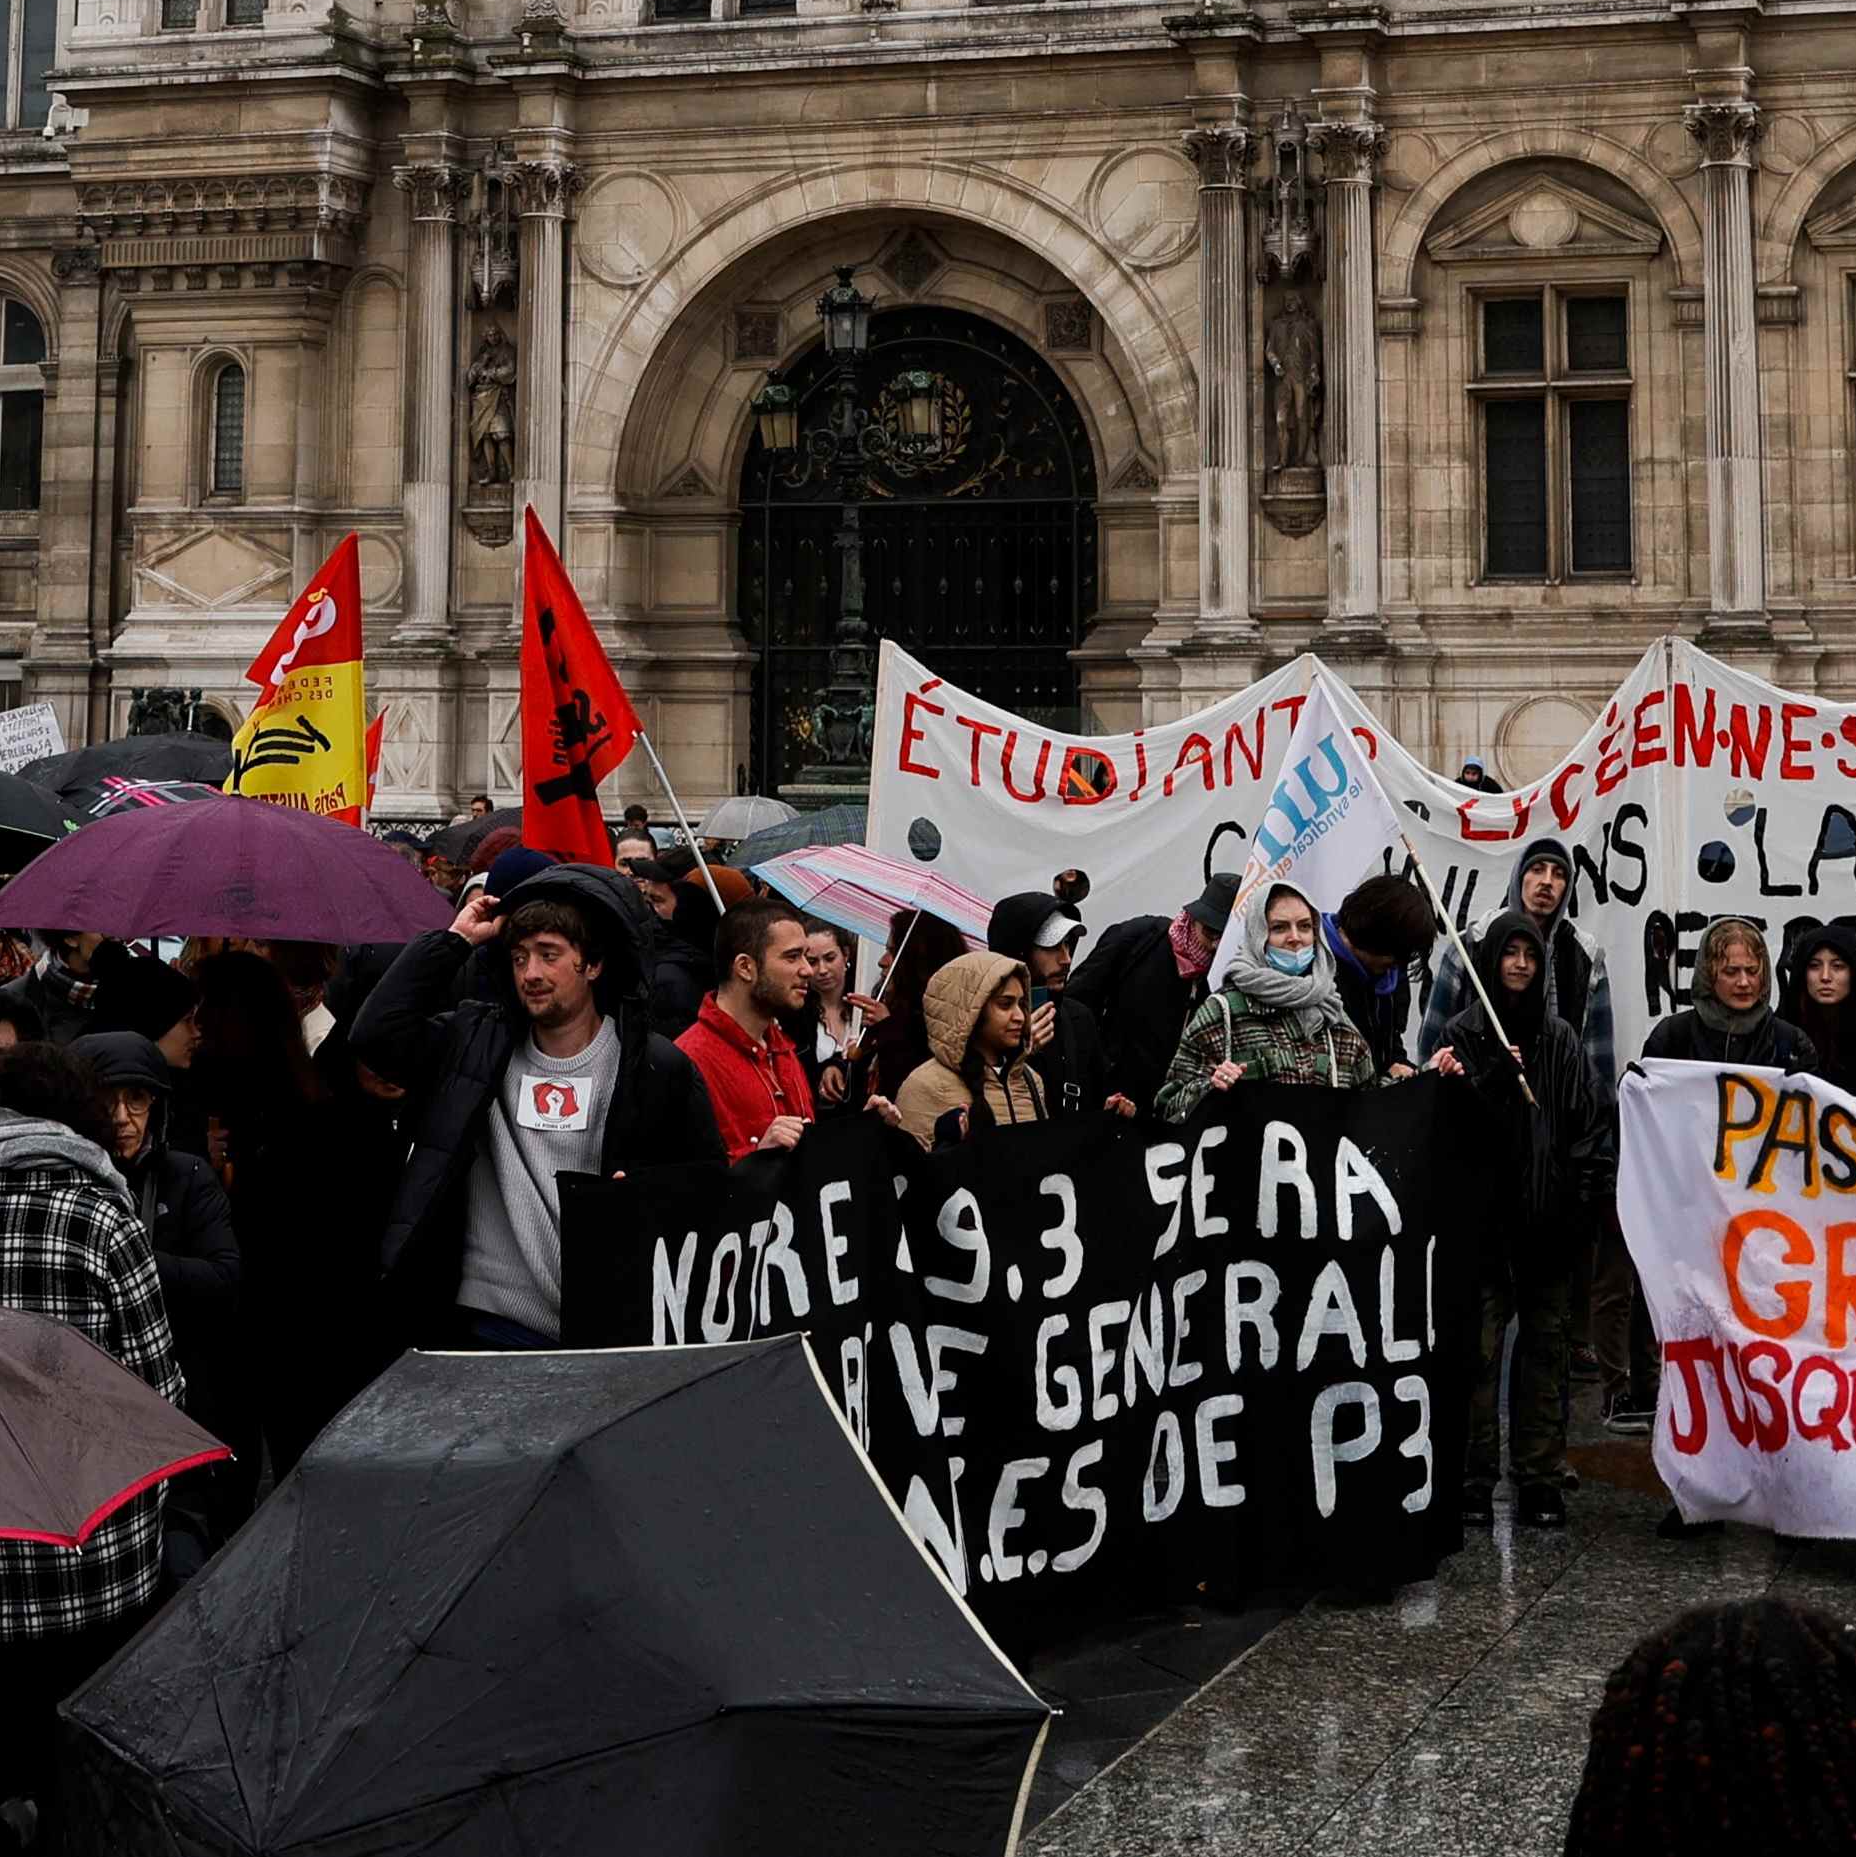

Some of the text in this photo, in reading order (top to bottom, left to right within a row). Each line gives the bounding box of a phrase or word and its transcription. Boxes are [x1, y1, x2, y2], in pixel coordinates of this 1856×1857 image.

[651, 1178, 861, 1348] NOTRE
[1144, 1120, 1403, 1262] SERA
[1142, 1392, 1247, 1523] DE
[1310, 1374, 1435, 1519] P3
